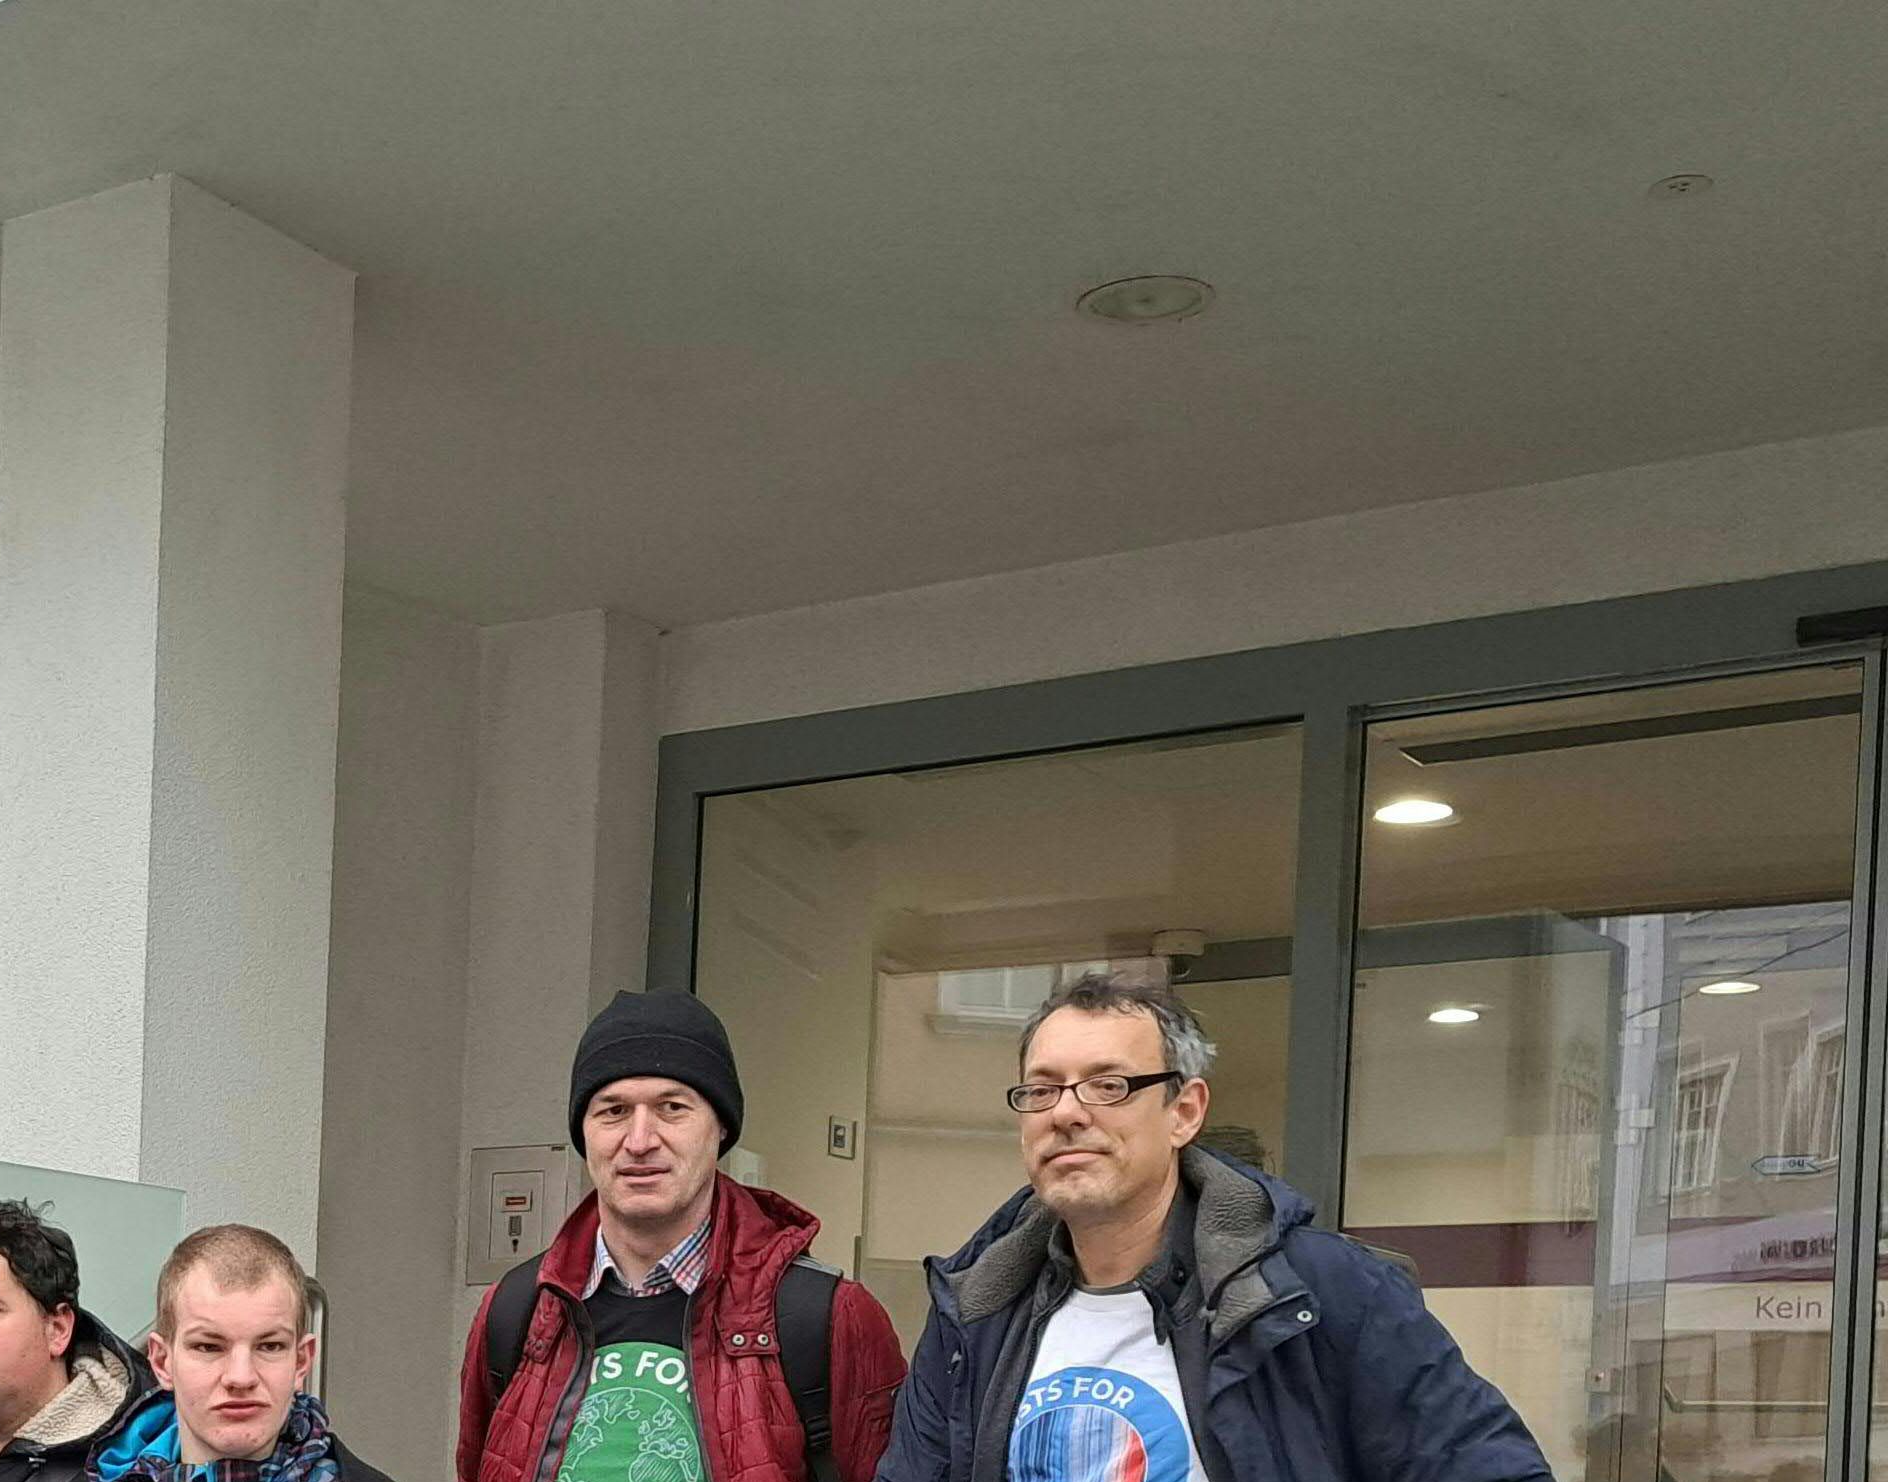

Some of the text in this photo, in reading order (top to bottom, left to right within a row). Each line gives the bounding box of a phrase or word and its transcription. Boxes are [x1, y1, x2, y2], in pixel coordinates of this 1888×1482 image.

[1755, 1296, 1823, 1319] Kein
[635, 1350, 691, 1404] FO
[1073, 1376, 1135, 1409] FOR
